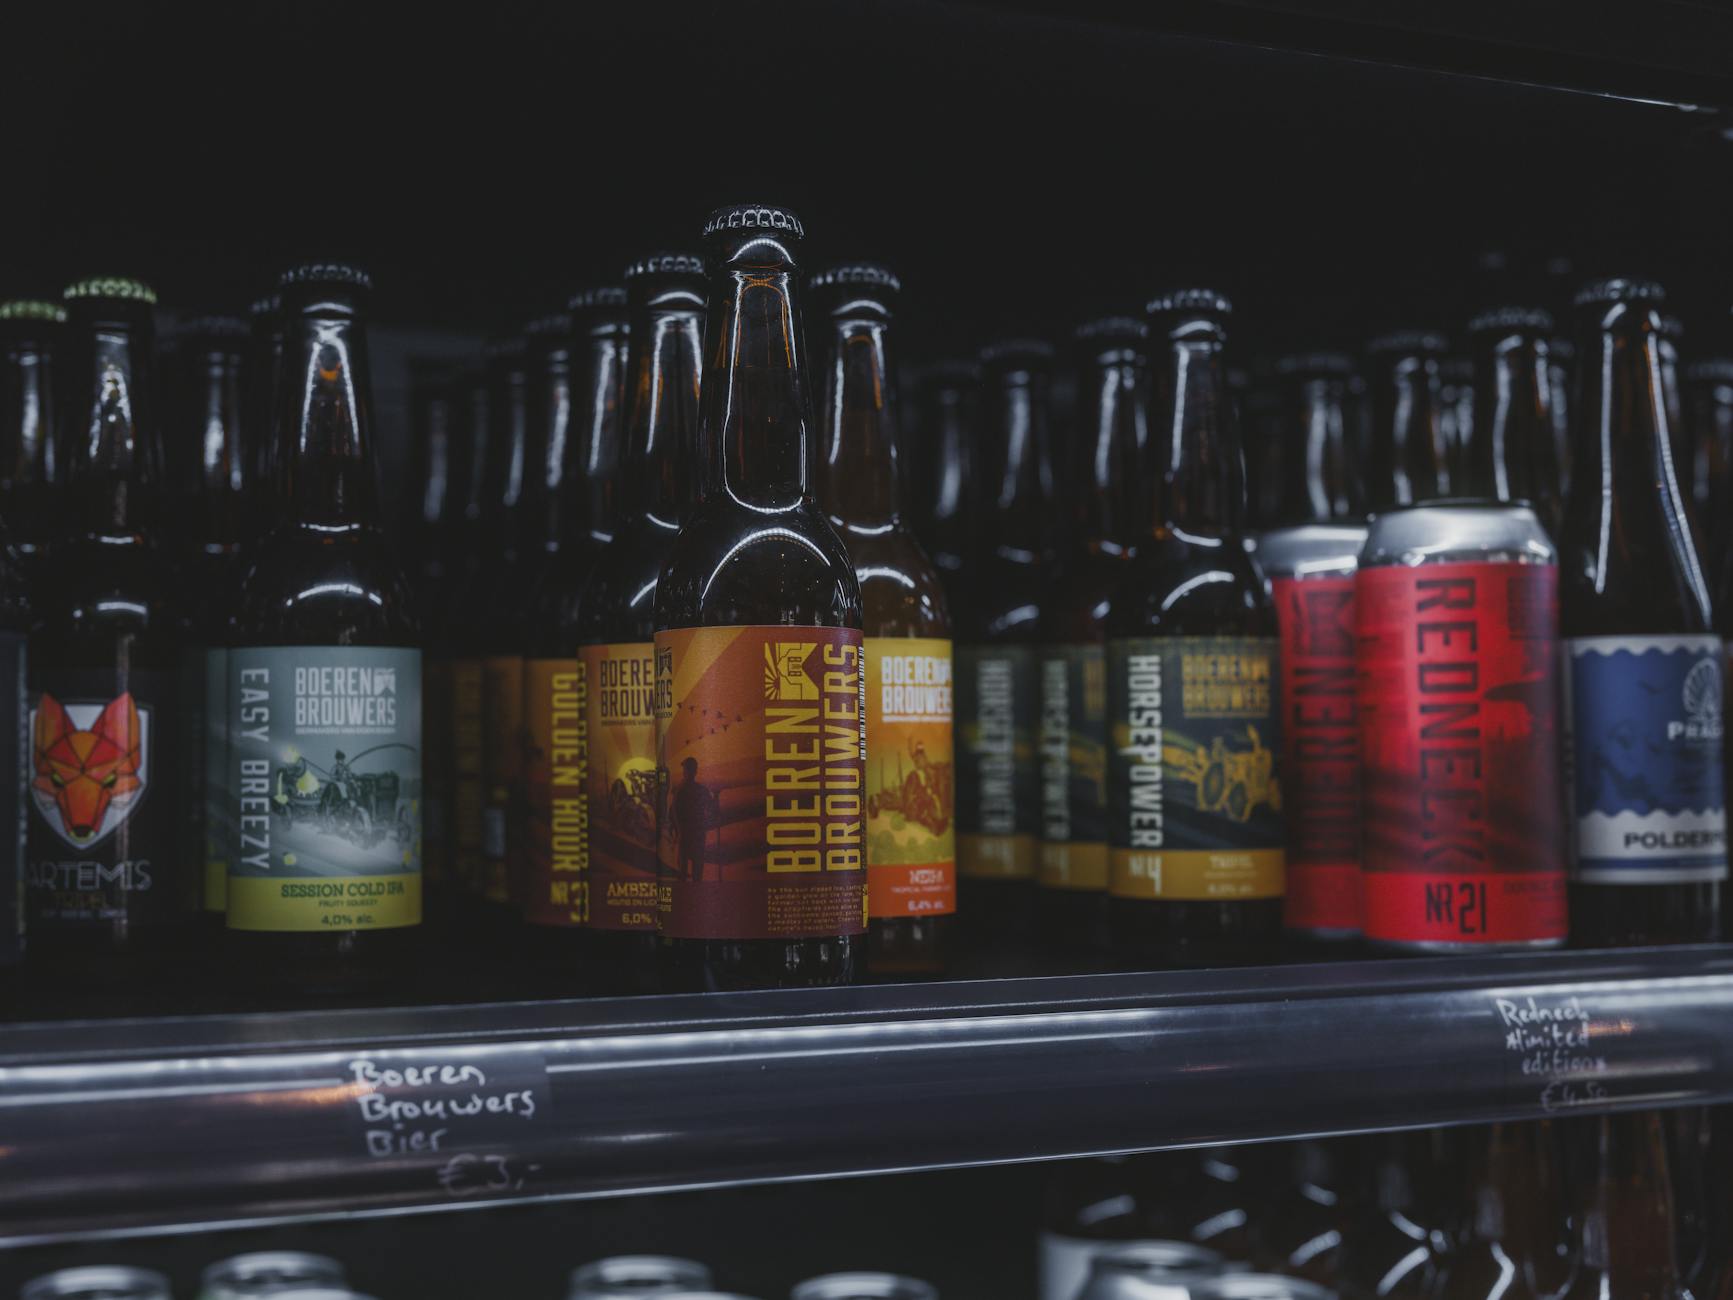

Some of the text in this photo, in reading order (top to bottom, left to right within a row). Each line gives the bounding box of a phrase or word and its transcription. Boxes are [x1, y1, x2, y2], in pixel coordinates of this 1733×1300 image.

[296, 667, 372, 696] BOEREN
[600, 659, 654, 687] BOERE
[296, 697, 396, 726] BROUWERS
[600, 689, 655, 717] BROUW
[1415, 577, 1484, 862] REDNECK
[823, 643, 861, 872] BROUWERS
[1119, 655, 1163, 847] HORSEPOWER
[240, 668, 270, 869] EASY BREEZY
[764, 707, 821, 873] BOEREN
[28, 859, 152, 891] ARTEMIS
[281, 881, 405, 898] SESSION COLD IPA
[321, 914, 353, 927] 4,0%
[1426, 881, 1487, 935] NR 21
[349, 1059, 486, 1087] Boeren
[357, 1089, 536, 1122] Brouwers
[365, 1122, 448, 1158] Bier
